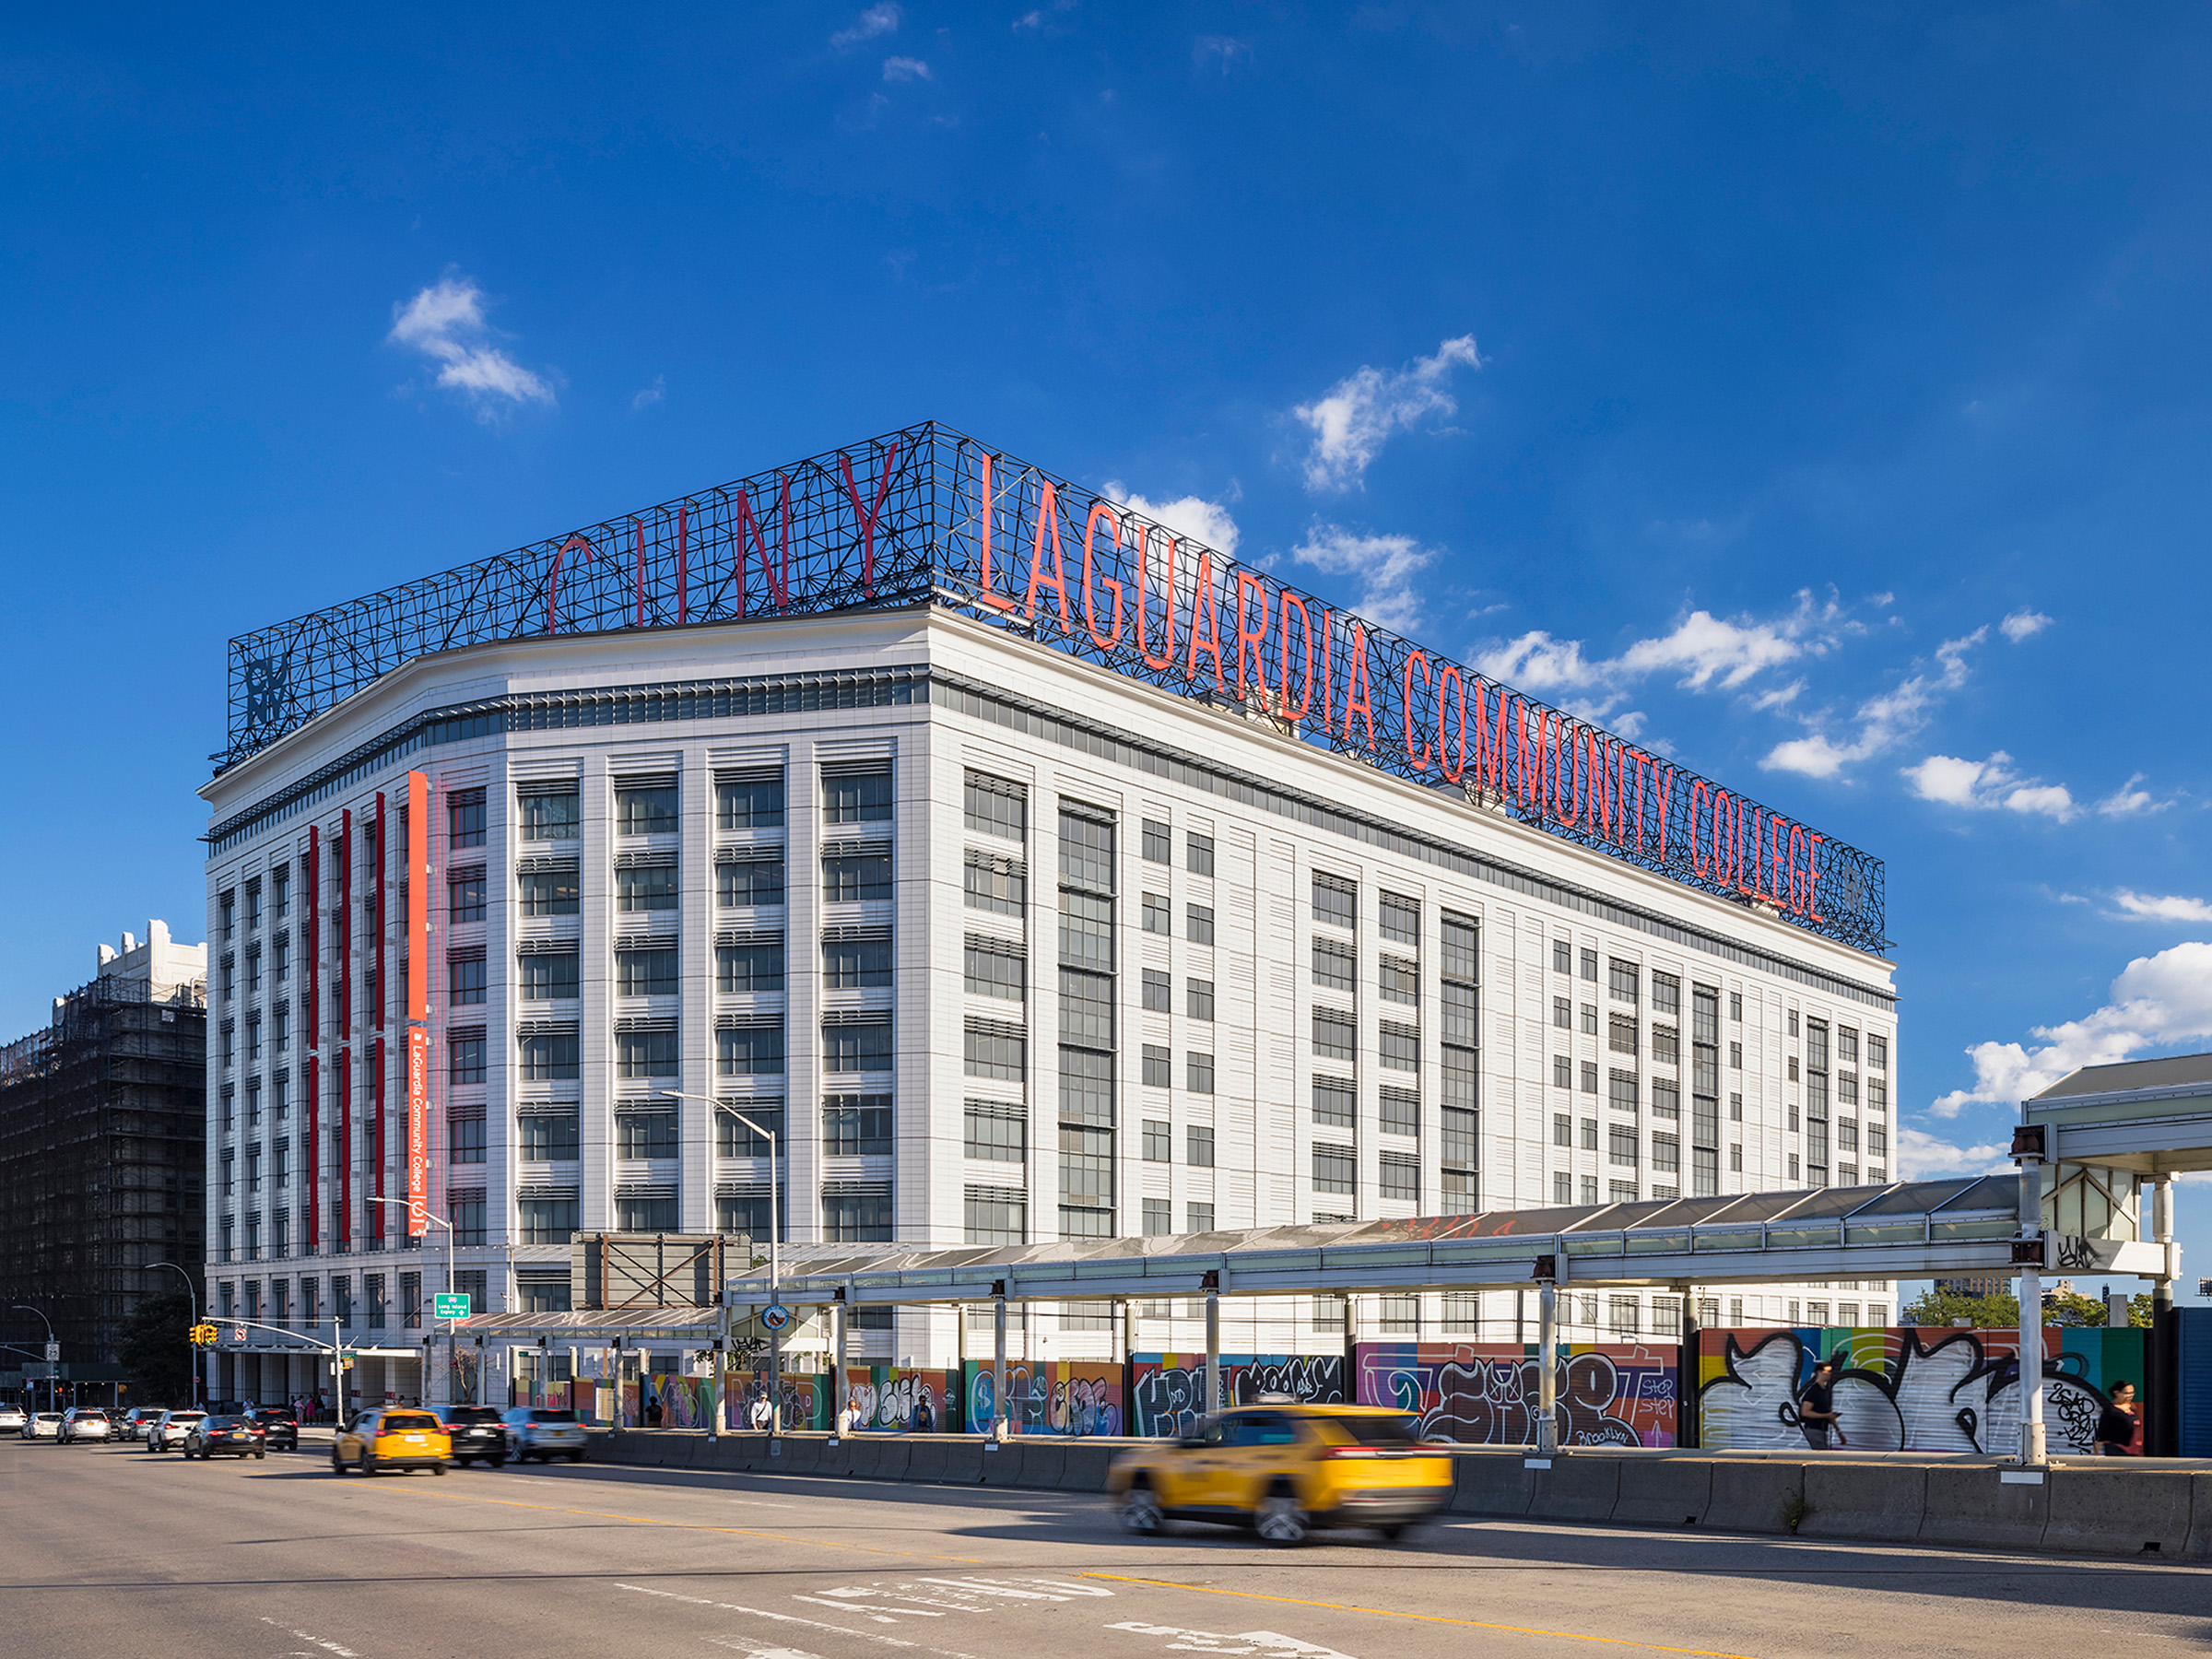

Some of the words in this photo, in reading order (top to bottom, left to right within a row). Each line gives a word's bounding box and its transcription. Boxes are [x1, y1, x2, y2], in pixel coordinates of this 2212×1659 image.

[982, 453, 1376, 751] LAGUARDIA
[1404, 649, 1674, 863] COMMUNITY
[1690, 780, 1824, 924] COLLEGE
[412, 1045, 423, 1096] LaGuardia
[412, 1097, 422, 1155] Community
[411, 1156, 422, 1193] College
